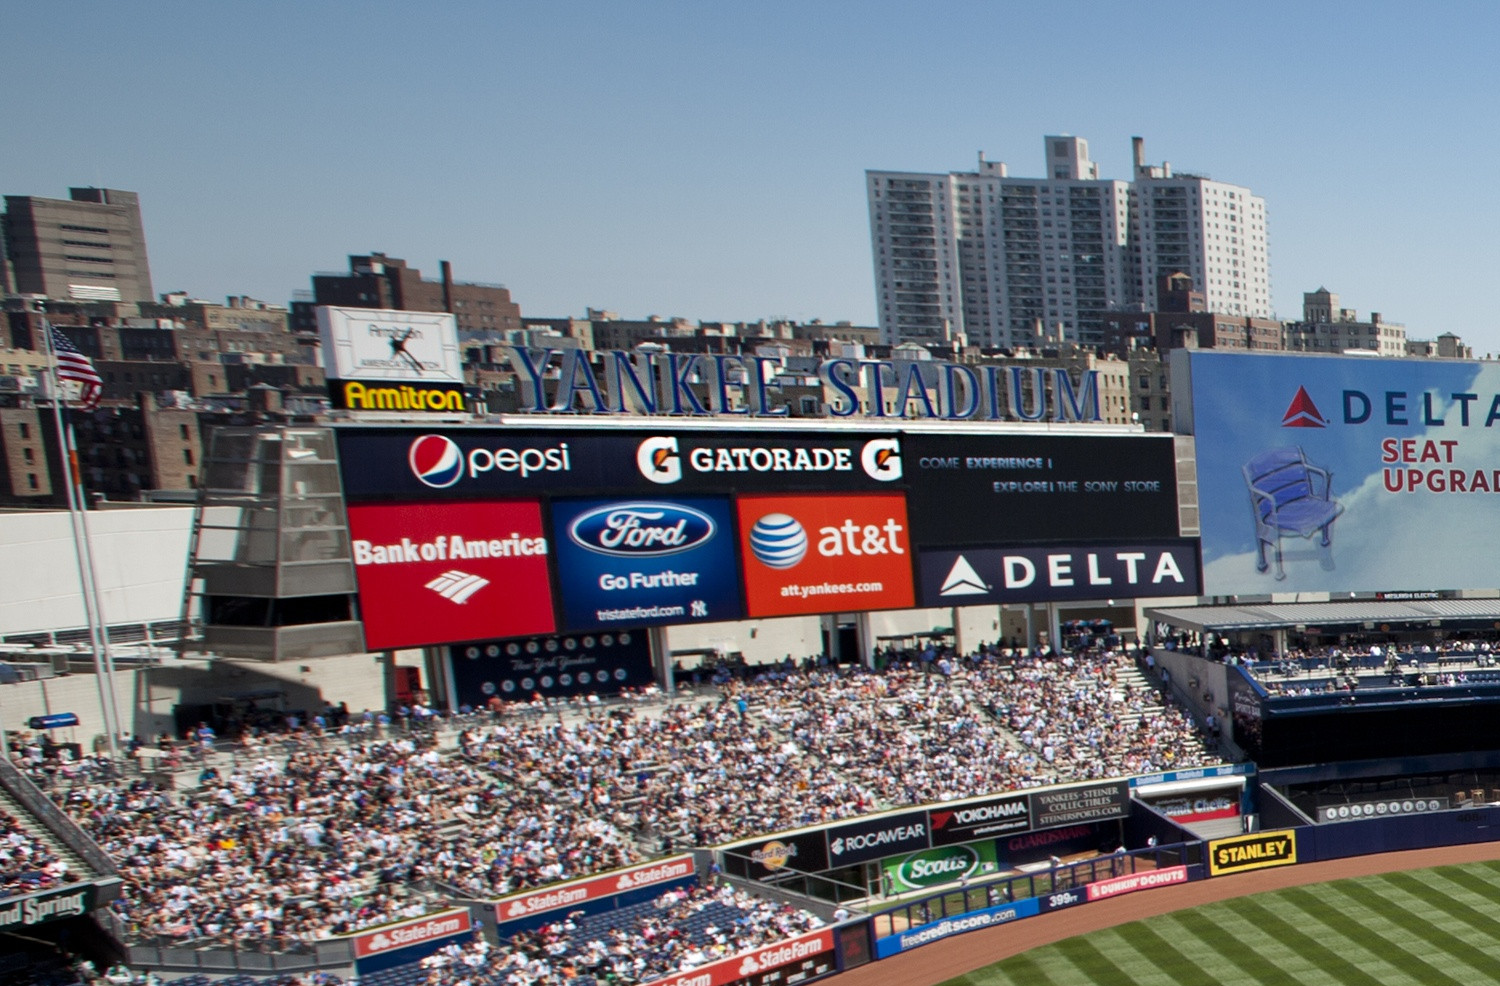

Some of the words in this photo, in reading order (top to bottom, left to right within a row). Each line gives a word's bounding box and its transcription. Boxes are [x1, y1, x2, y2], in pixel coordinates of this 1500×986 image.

[344, 381, 465, 410] Armitron
[509, 344, 789, 417] YANKEE
[818, 357, 1104, 423] STADIUM
[468, 442, 571, 477] pepsi
[636, 436, 682, 484] G
[690, 447, 852, 472] GATORADE
[860, 437, 903, 481] G
[919, 457, 960, 469] COME
[965, 457, 1044, 469] EXPERIENCE
[1381, 438, 1459, 464] SEAT
[1057, 481, 1078, 493] THE
[1085, 481, 1118, 493] SONY
[1124, 481, 1161, 493] STORE
[600, 510, 688, 549] Ford
[817, 518, 904, 557] at&t
[353, 537, 417, 565] Bank
[419, 535, 448, 560] of
[449, 533, 548, 560] America
[599, 572, 628, 592] Go
[629, 569, 699, 589] Further
[1002, 551, 1184, 589] DELTA
[780, 581, 883, 599] att.yankees.com
[597, 602, 684, 620] tristateford.com
[1039, 792, 1078, 805] YANKEES
[1083, 786, 1119, 799] STEINER
[1049, 796, 1112, 813] COLLECTIBLES
[1194, 798, 1230, 813] Chews
[953, 801, 1027, 825] YOKOHAMA
[1039, 806, 1122, 825] STEINERSPORTS.COM
[845, 823, 926, 851] ROCAWEAR
[1008, 825, 1091, 851] GUARDSMARK
[1218, 840, 1287, 864] STANLEY
[910, 854, 967, 879] Scotts
[1100, 877, 1140, 895] DUNKIN'
[1140, 869, 1184, 886] DONUTS
[23, 891, 88, 925] Spring
[900, 907, 1016, 949] freecreditscore.com
